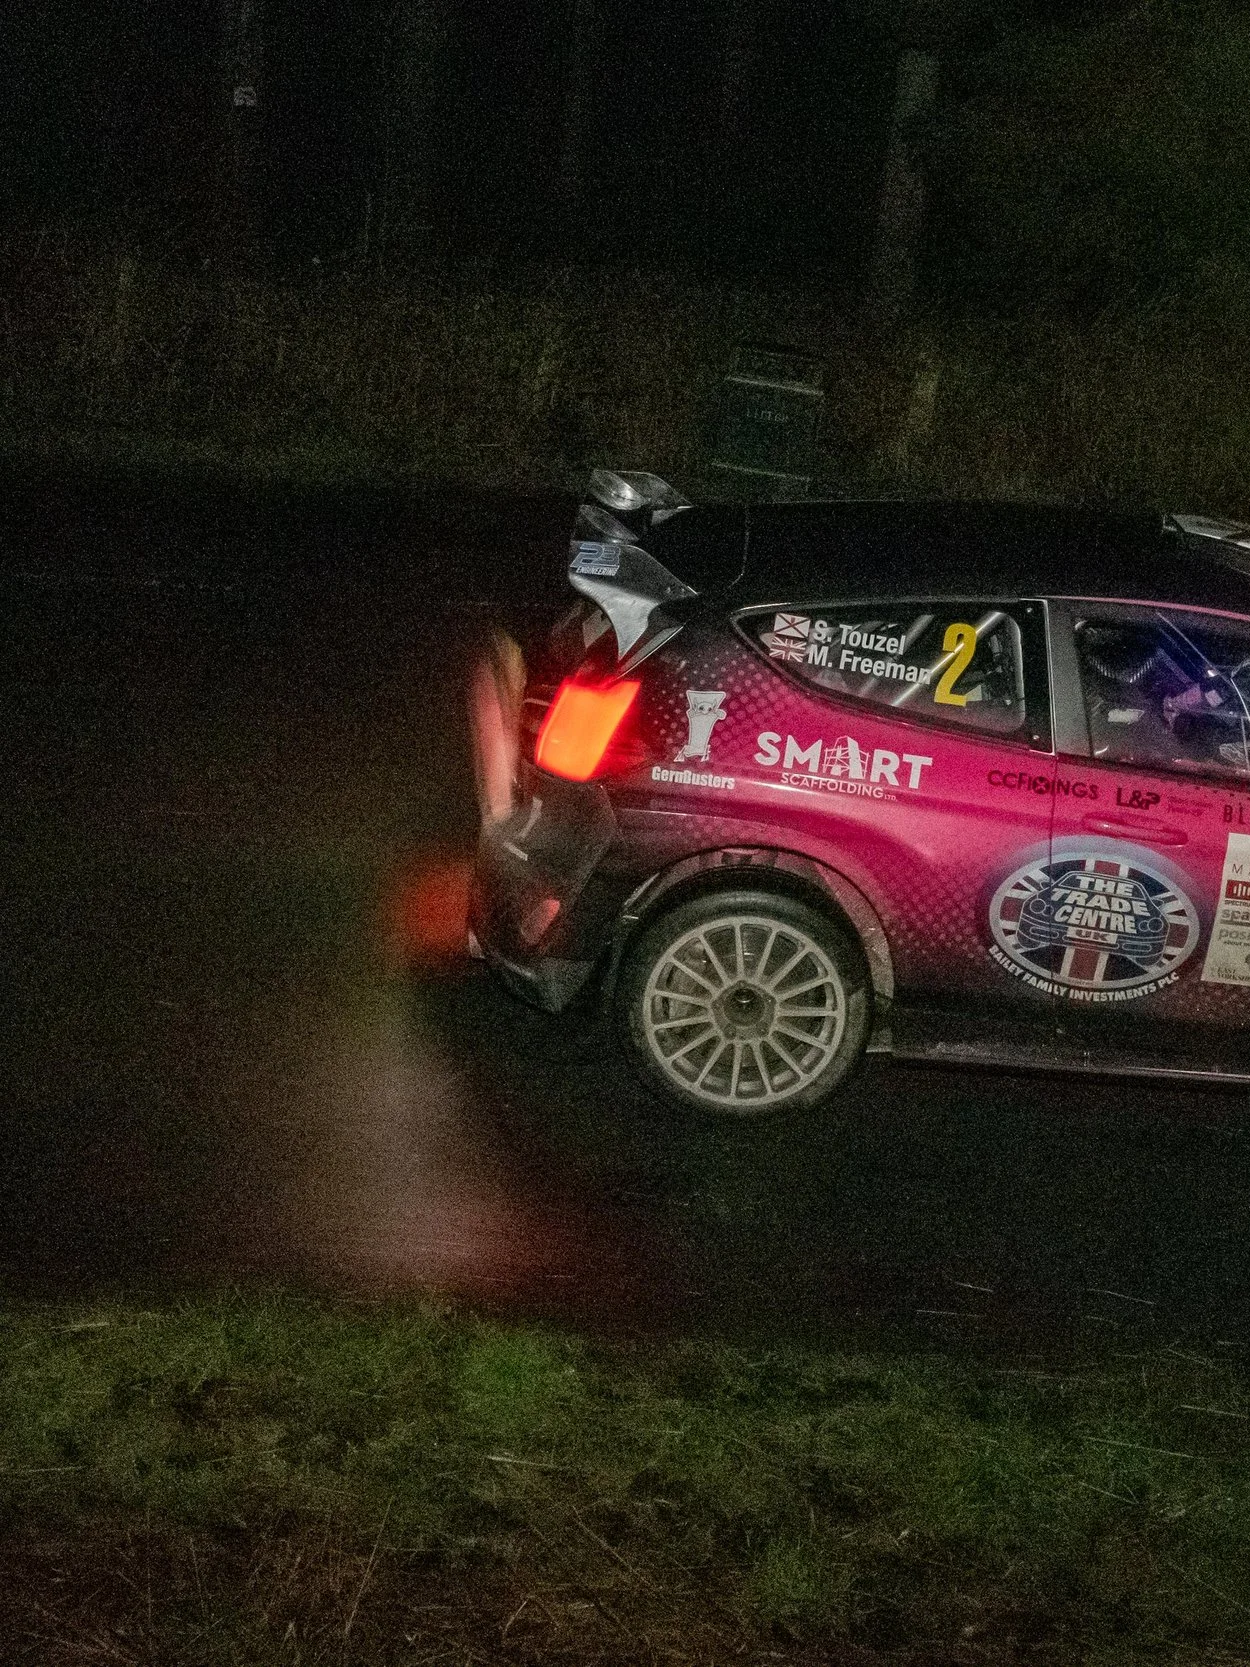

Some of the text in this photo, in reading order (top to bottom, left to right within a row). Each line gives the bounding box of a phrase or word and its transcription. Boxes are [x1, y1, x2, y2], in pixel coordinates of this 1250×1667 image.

[813, 619, 906, 656] S. Touzel
[807, 645, 931, 685] M. Freeman
[934, 622, 977, 707] 2
[754, 731, 933, 790] SMART
[651, 766, 735, 790] GernBusters
[780, 772, 884, 799] SCAFFOLDING
[1076, 875, 1134, 897] THE
[1051, 888, 1151, 917] TRADE
[1054, 905, 1138, 935] CENTRE
[1075, 929, 1110, 943] UK
[988, 944, 1180, 1001] BAILEY FAMILY INVESTMENTS PLC
